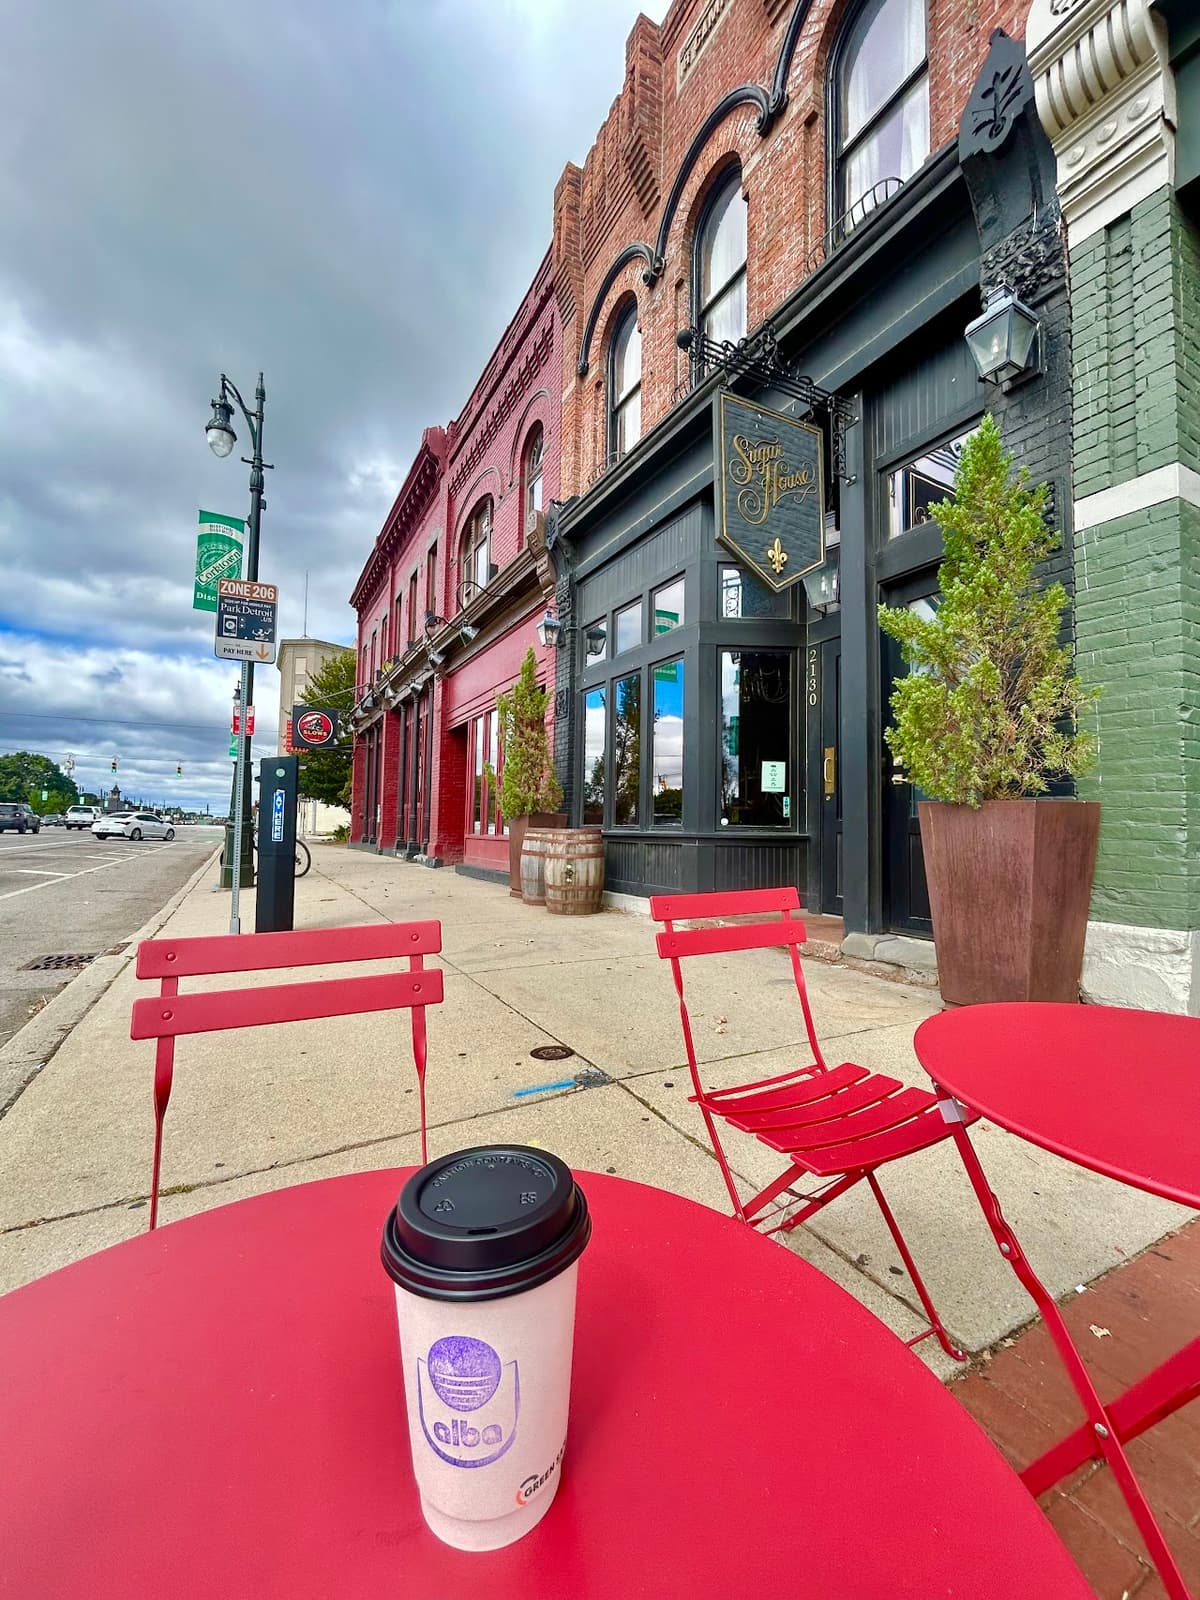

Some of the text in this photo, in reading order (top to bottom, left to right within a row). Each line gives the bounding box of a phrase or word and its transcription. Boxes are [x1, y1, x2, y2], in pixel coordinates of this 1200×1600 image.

[729, 434, 785, 485] Sugar
[738, 460, 817, 525] House
[198, 551, 241, 584] Corktown
[220, 580, 275, 600] ZONE 206
[808, 649, 817, 706] 2130
[303, 729, 328, 737] SLOWS
[273, 811, 282, 839] HERE
[431, 1159, 475, 1189] CAUTION
[433, 1419, 503, 1448] alba
[524, 1461, 555, 1498] GREEN
